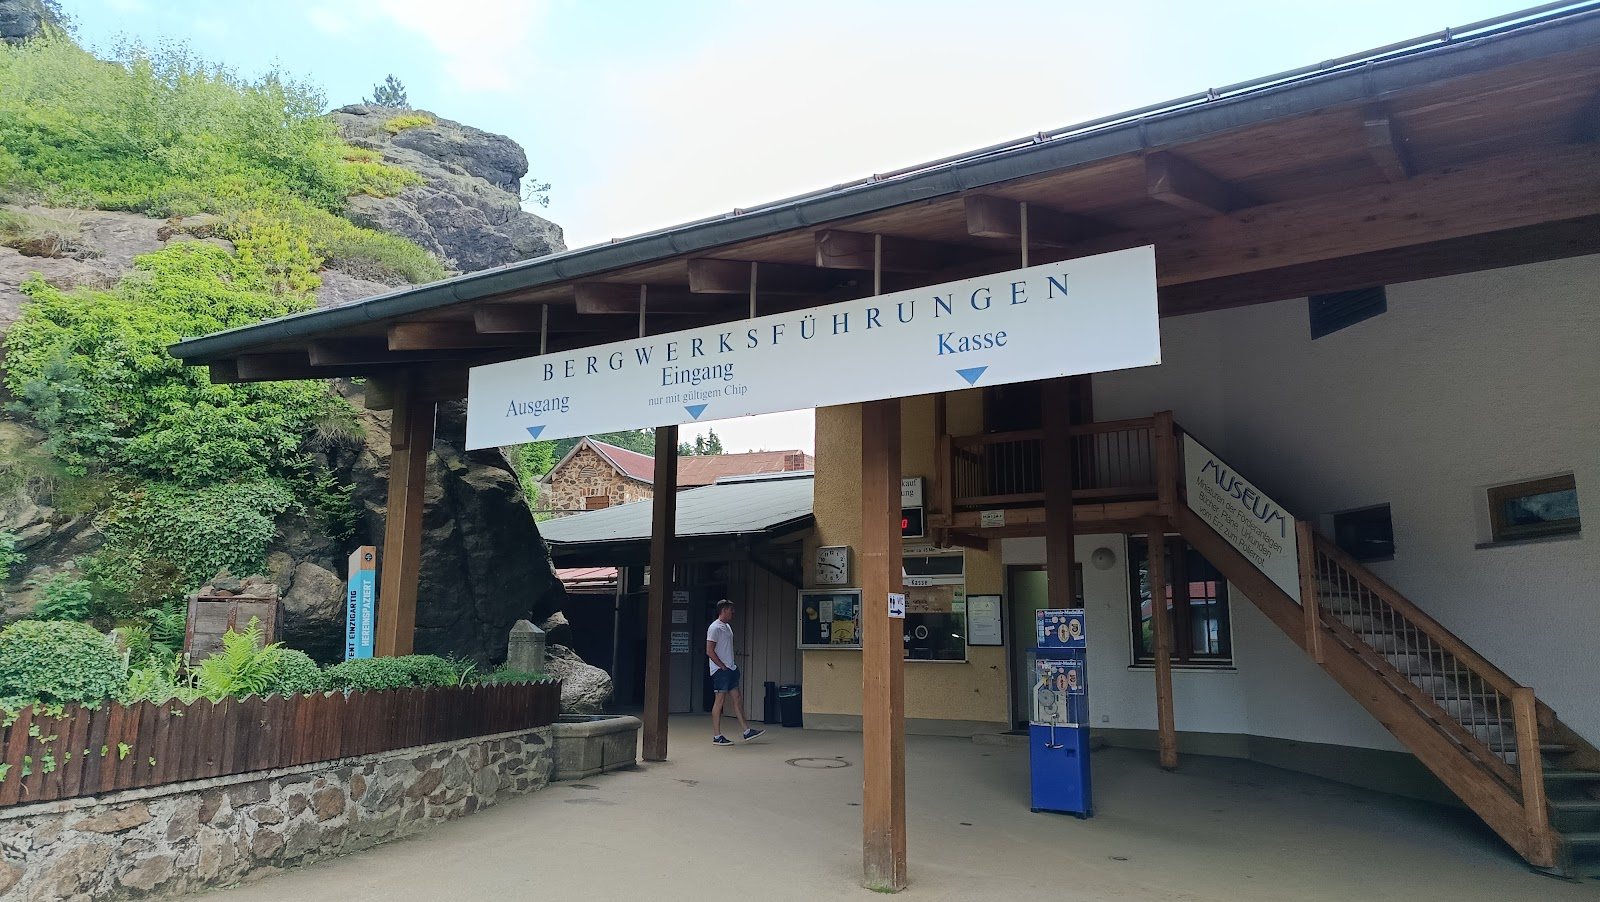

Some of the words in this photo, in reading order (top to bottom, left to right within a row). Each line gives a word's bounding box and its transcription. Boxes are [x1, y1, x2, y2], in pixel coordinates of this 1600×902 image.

[543, 273, 1070, 382] BERGWERKSFÜHRUNGEN
[936, 330, 1008, 357] Kasse
[661, 362, 734, 386] Eingang
[506, 395, 570, 417] Ausgang
[648, 396, 664, 406] nur
[665, 392, 681, 404] mit
[682, 387, 721, 404] gültigem
[724, 384, 748, 398] Chip
[1201, 458, 1286, 538] MUSEUM
[1225, 501, 1237, 515] der
[1199, 506, 1212, 522] vom
[1212, 516, 1223, 533] Erz
[1224, 527, 1238, 543] zum
[1241, 526, 1272, 558] Urkunden
[349, 590, 357, 639] EINZIGARTIG
[362, 580, 371, 647] HEREINSPAZIERT
